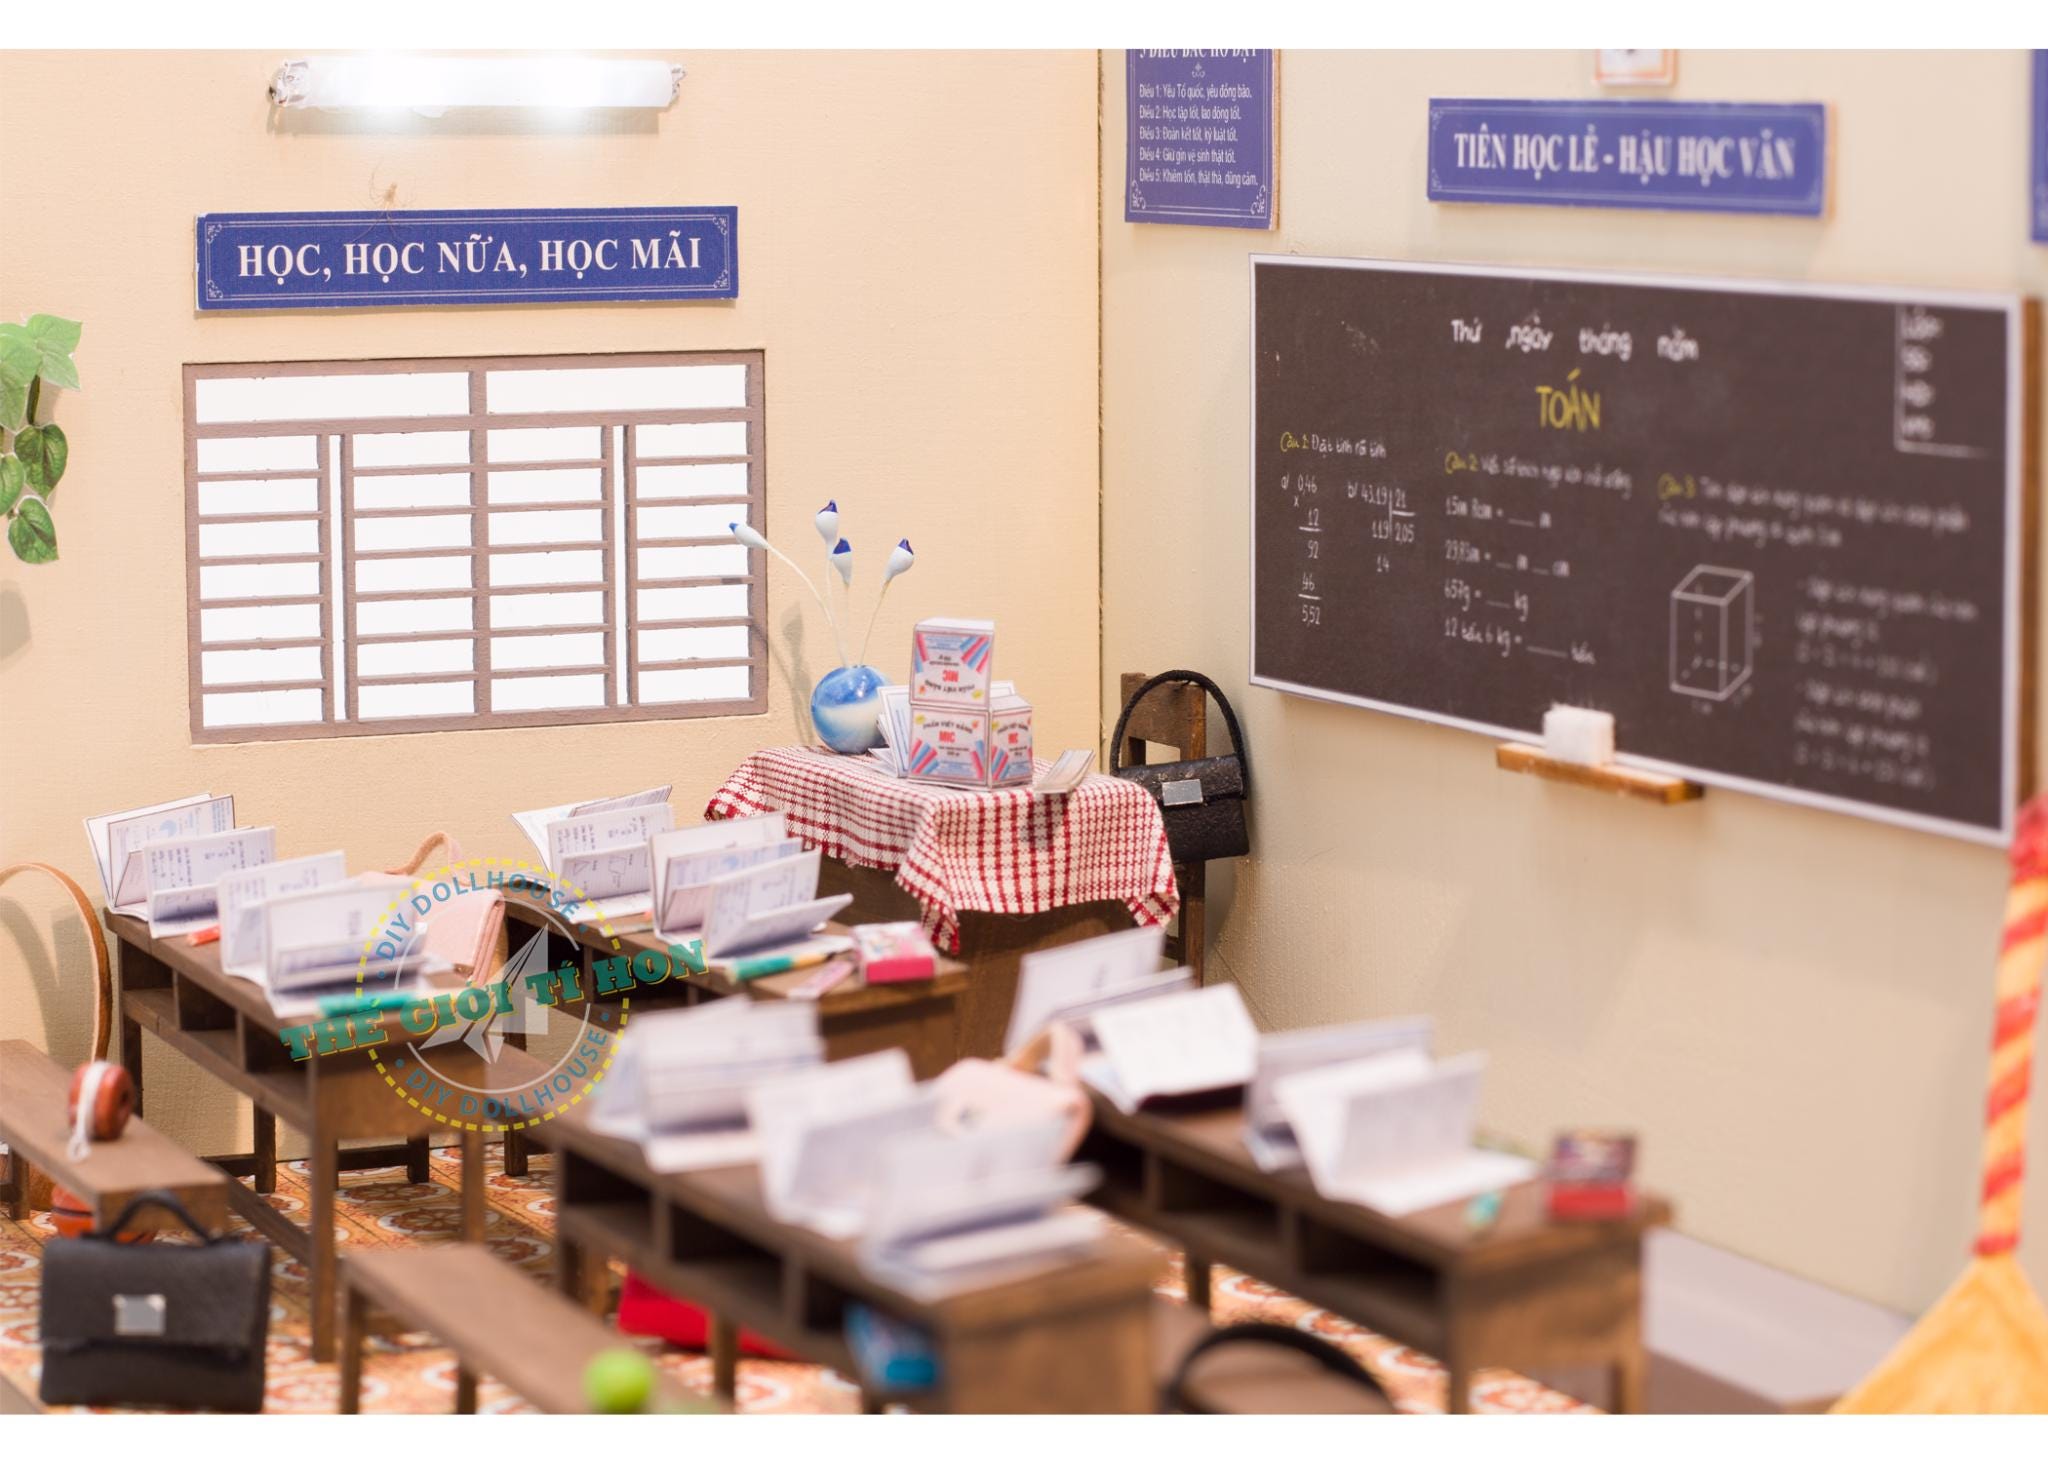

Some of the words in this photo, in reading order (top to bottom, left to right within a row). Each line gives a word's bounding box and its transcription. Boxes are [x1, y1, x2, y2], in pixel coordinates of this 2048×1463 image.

[1162, 104, 1176, 122] Học
[1513, 133, 1562, 181] HỌC
[1618, 129, 1671, 186] HẬU
[1678, 135, 1734, 187] HỌC
[238, 243, 332, 286] HỌC,
[344, 242, 426, 284] HỌC
[438, 233, 528, 279] NỮA,
[539, 238, 620, 280] HỌC
[630, 229, 702, 271] MÃI
[1536, 368, 1600, 433] TOÁN
